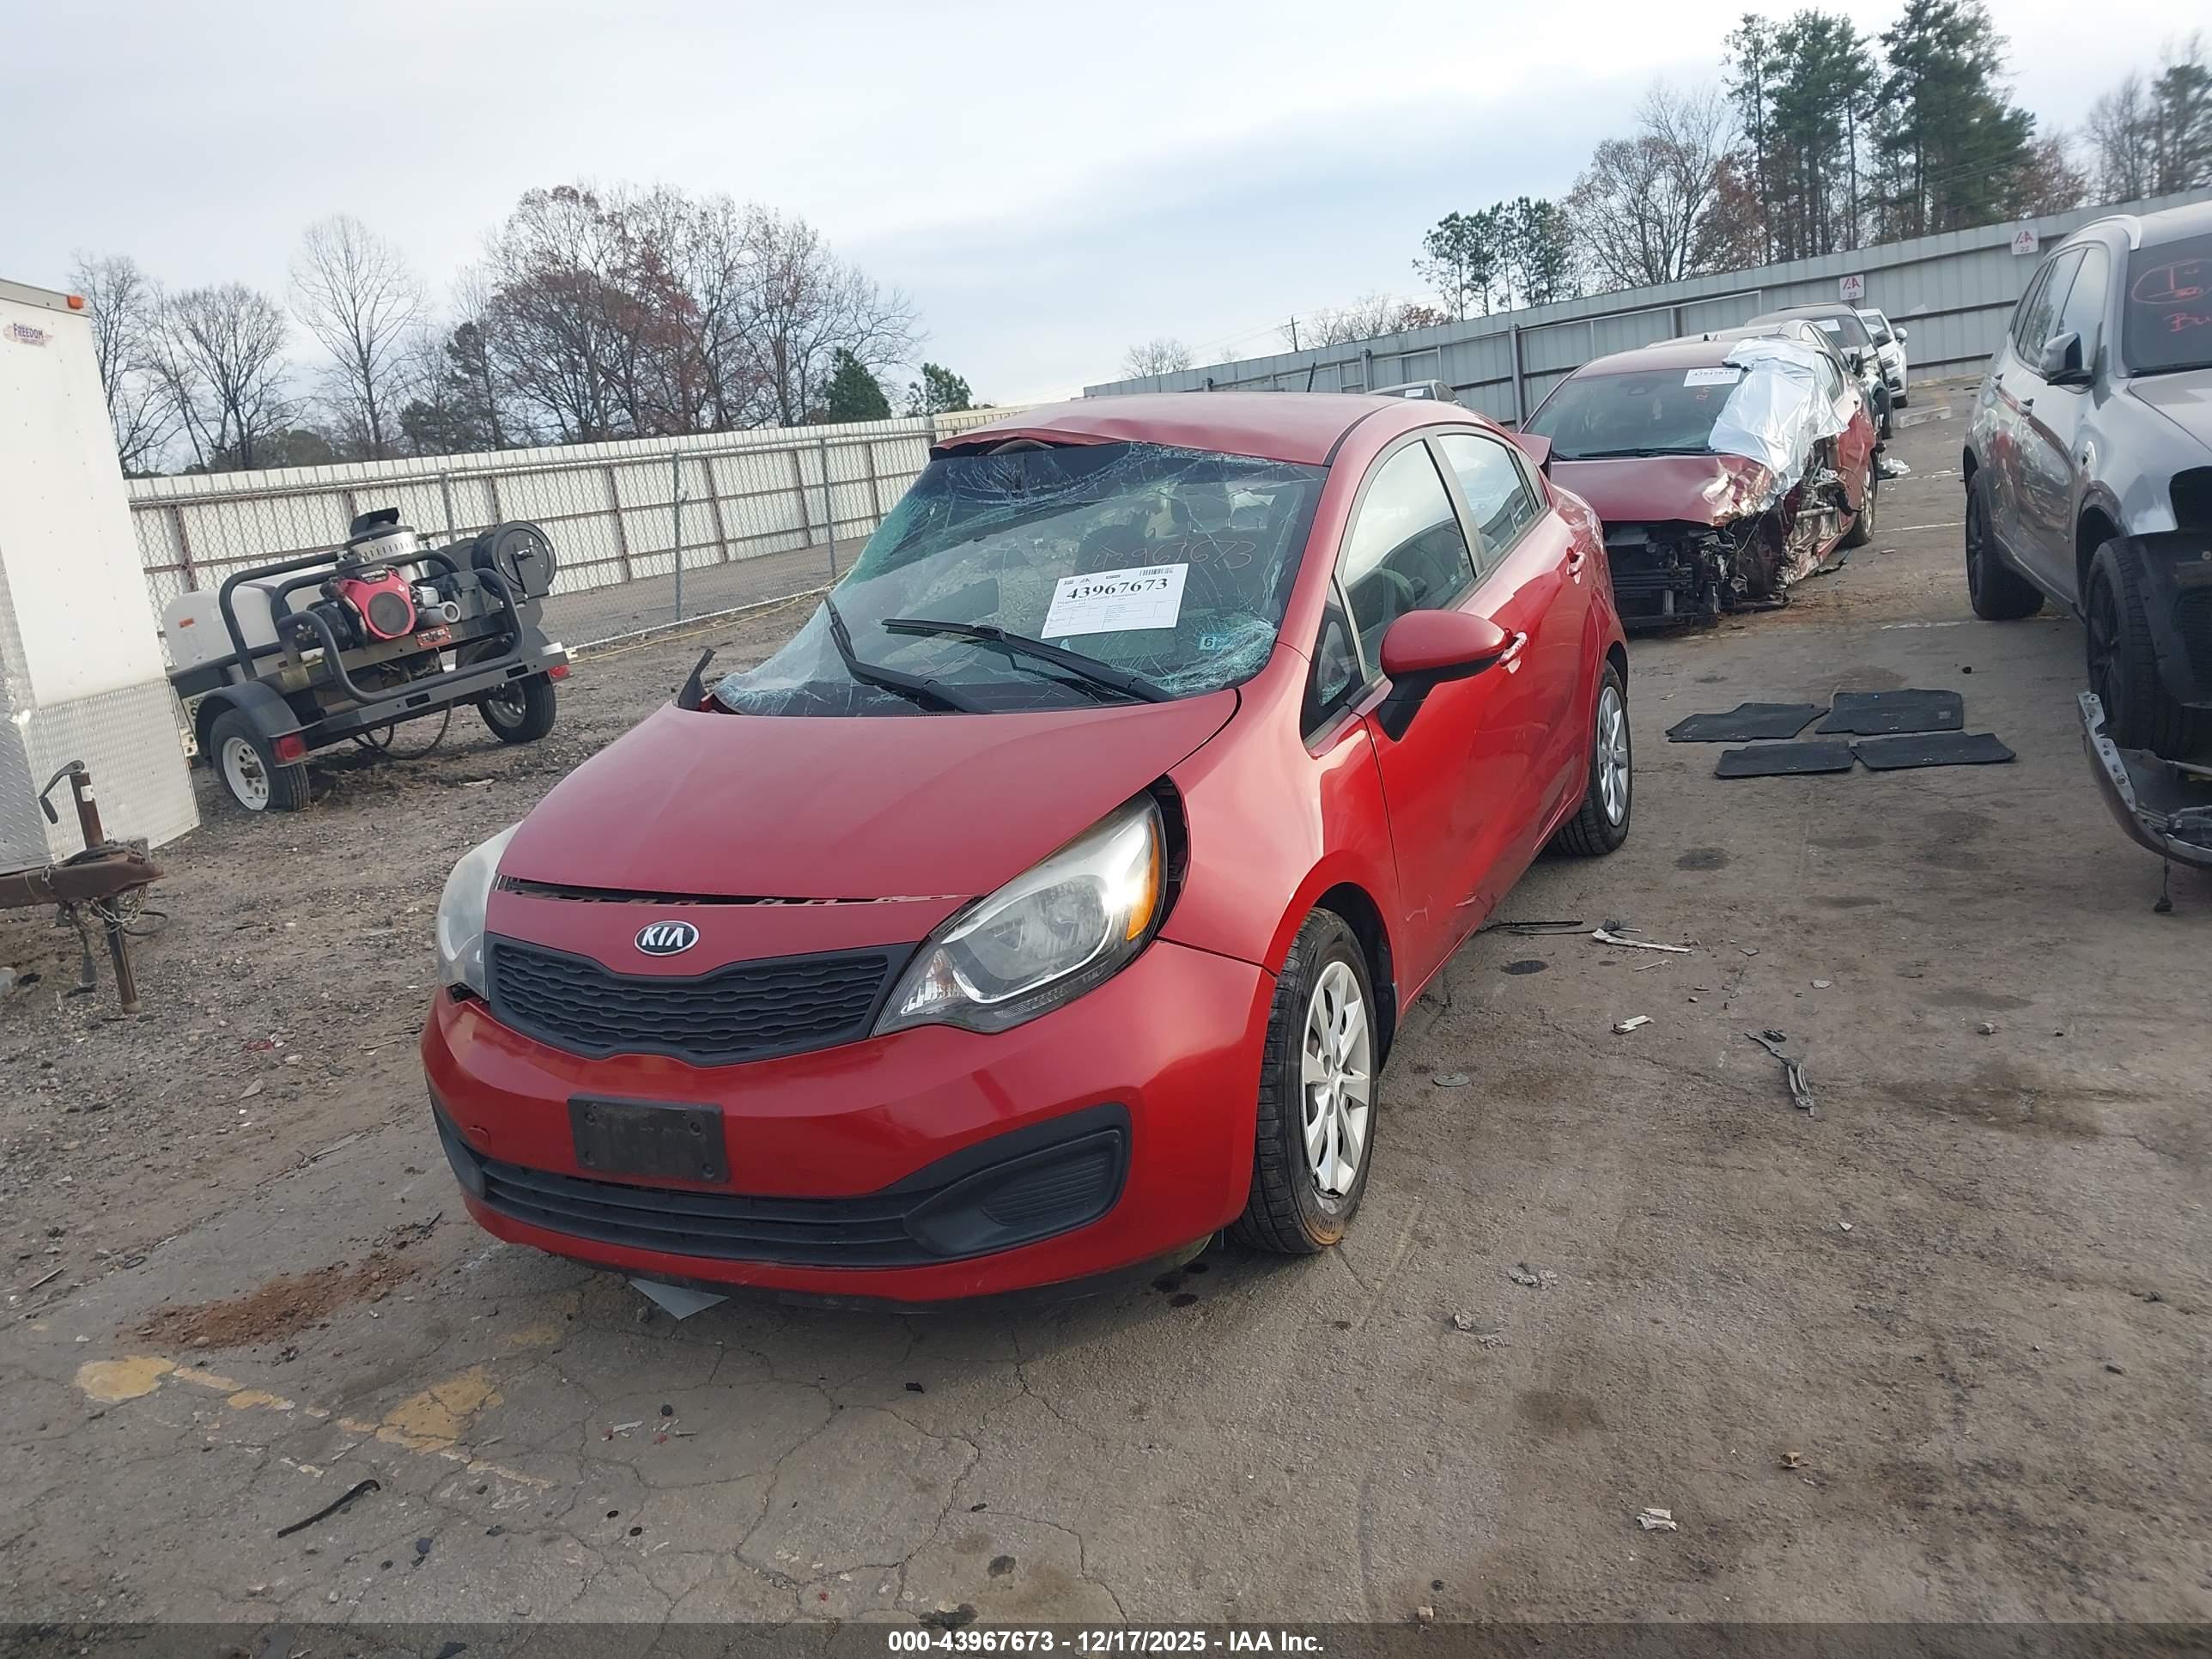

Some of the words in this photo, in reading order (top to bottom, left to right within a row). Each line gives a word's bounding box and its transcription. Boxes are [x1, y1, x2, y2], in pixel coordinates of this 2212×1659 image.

[13, 323, 44, 340] FREEDOM
[1092, 539, 1256, 570] 43967673
[1066, 578, 1169, 599] 43967673
[1204, 637, 1213, 647] 6
[641, 927, 685, 947] KIA
